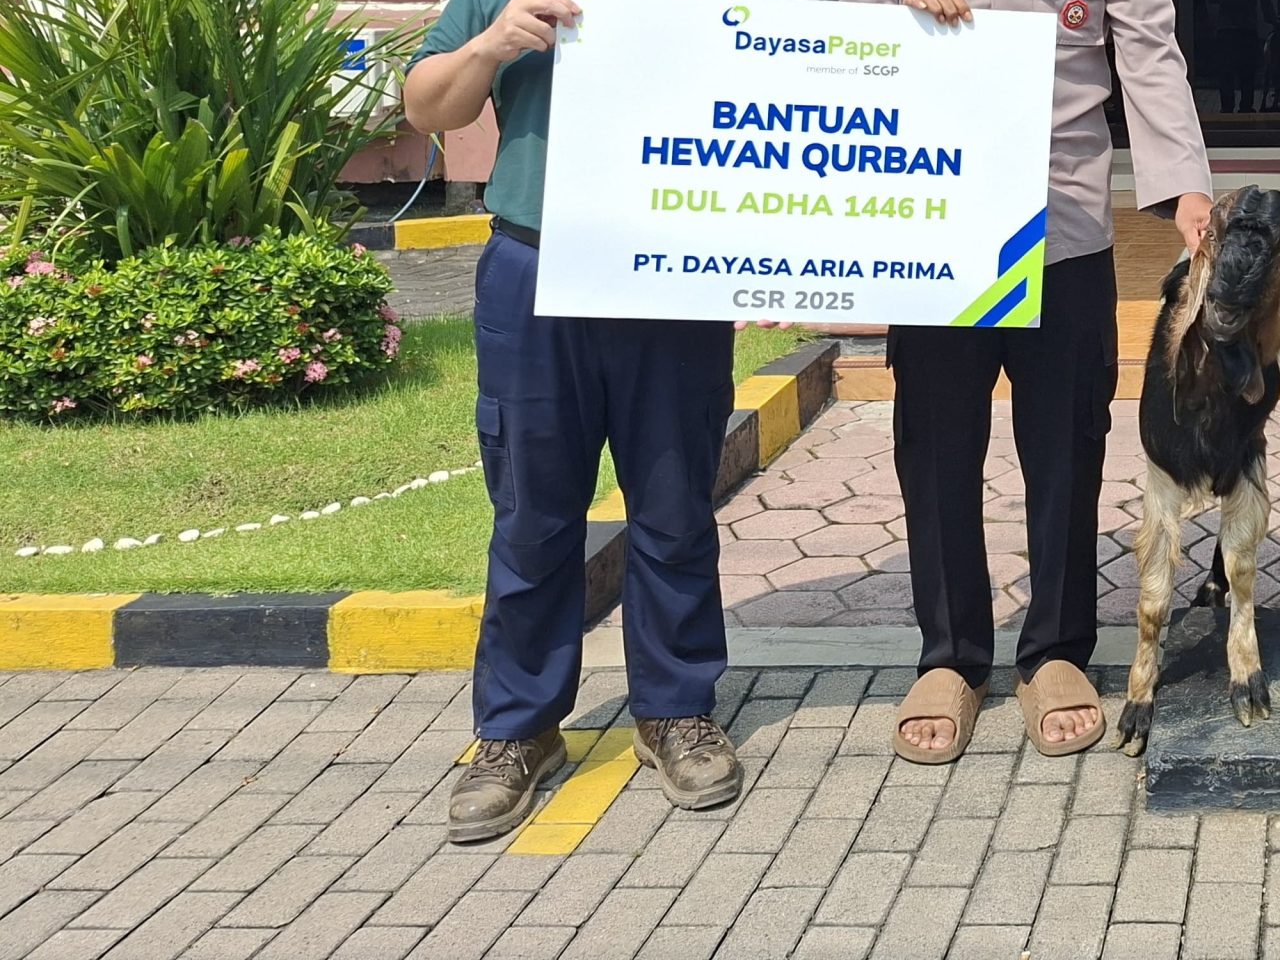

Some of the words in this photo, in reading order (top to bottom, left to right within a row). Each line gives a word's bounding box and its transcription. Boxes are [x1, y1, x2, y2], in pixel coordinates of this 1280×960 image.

[735, 30, 902, 61] DayasaPaper
[806, 65, 846, 76] member
[848, 66, 859, 76] of
[863, 64, 900, 77] SCGP
[713, 101, 900, 137] BANTUAN
[642, 136, 790, 170] HEWAN
[802, 143, 963, 178] QURBAN
[651, 188, 727, 213] IDUL
[736, 191, 834, 217] ADHA
[844, 195, 915, 220] 1446
[924, 197, 947, 220] H
[633, 253, 674, 273] PT.
[682, 255, 794, 277] DAYASA
[800, 258, 865, 279] ARIA
[873, 261, 956, 281] PRIMA
[732, 288, 785, 309] CSR
[794, 290, 855, 311] 2025
